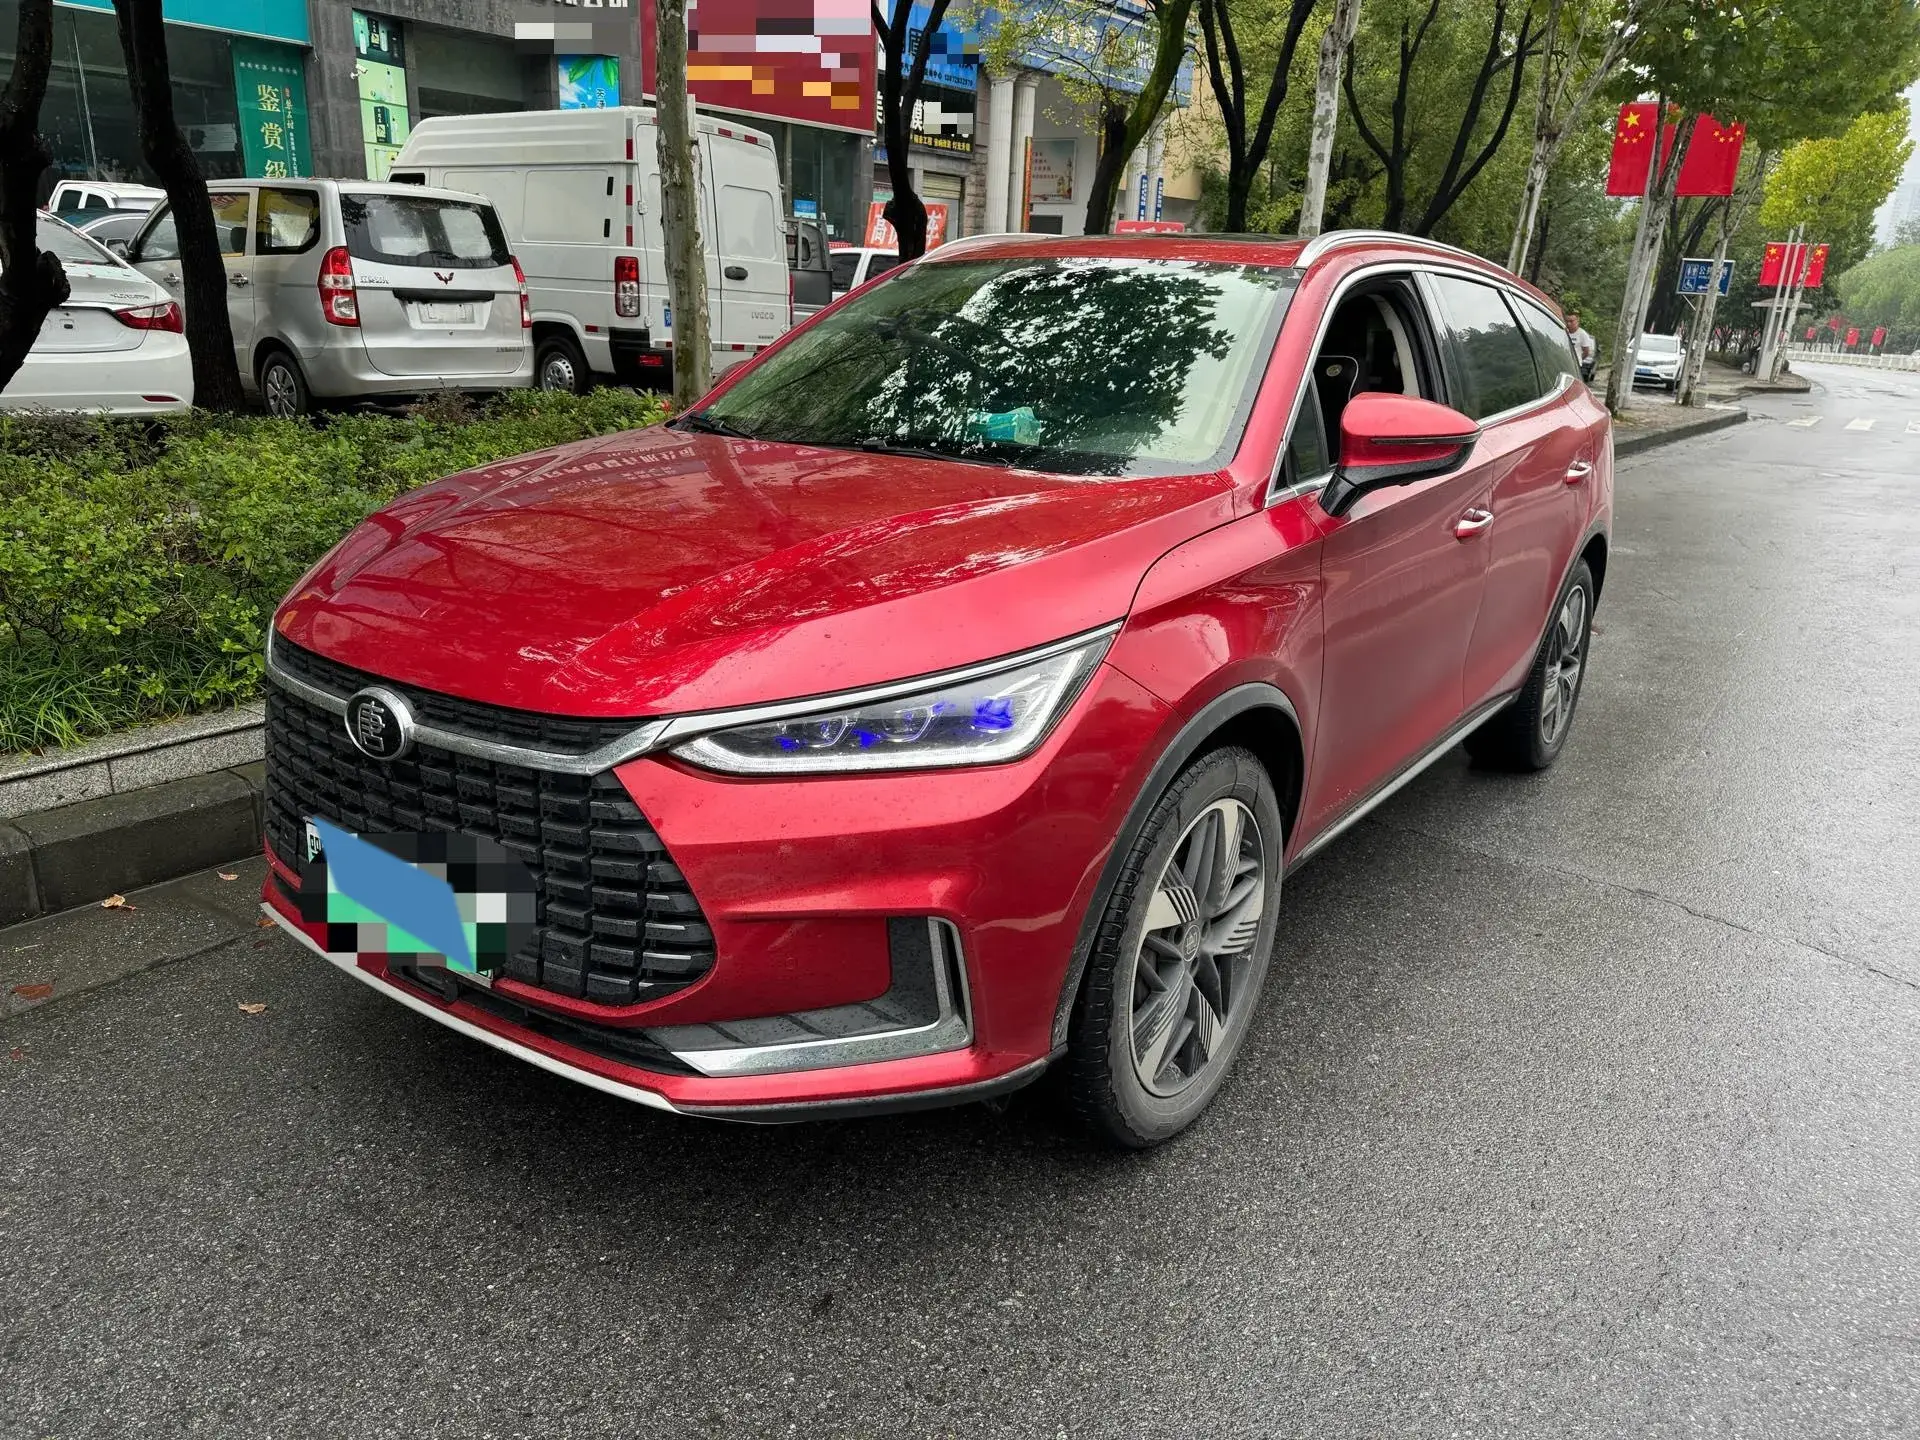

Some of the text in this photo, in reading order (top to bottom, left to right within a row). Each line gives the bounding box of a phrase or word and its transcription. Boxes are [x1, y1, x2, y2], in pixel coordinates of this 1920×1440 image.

[257, 84, 287, 178] 鉴赏级
[358, 700, 386, 752] 唐
